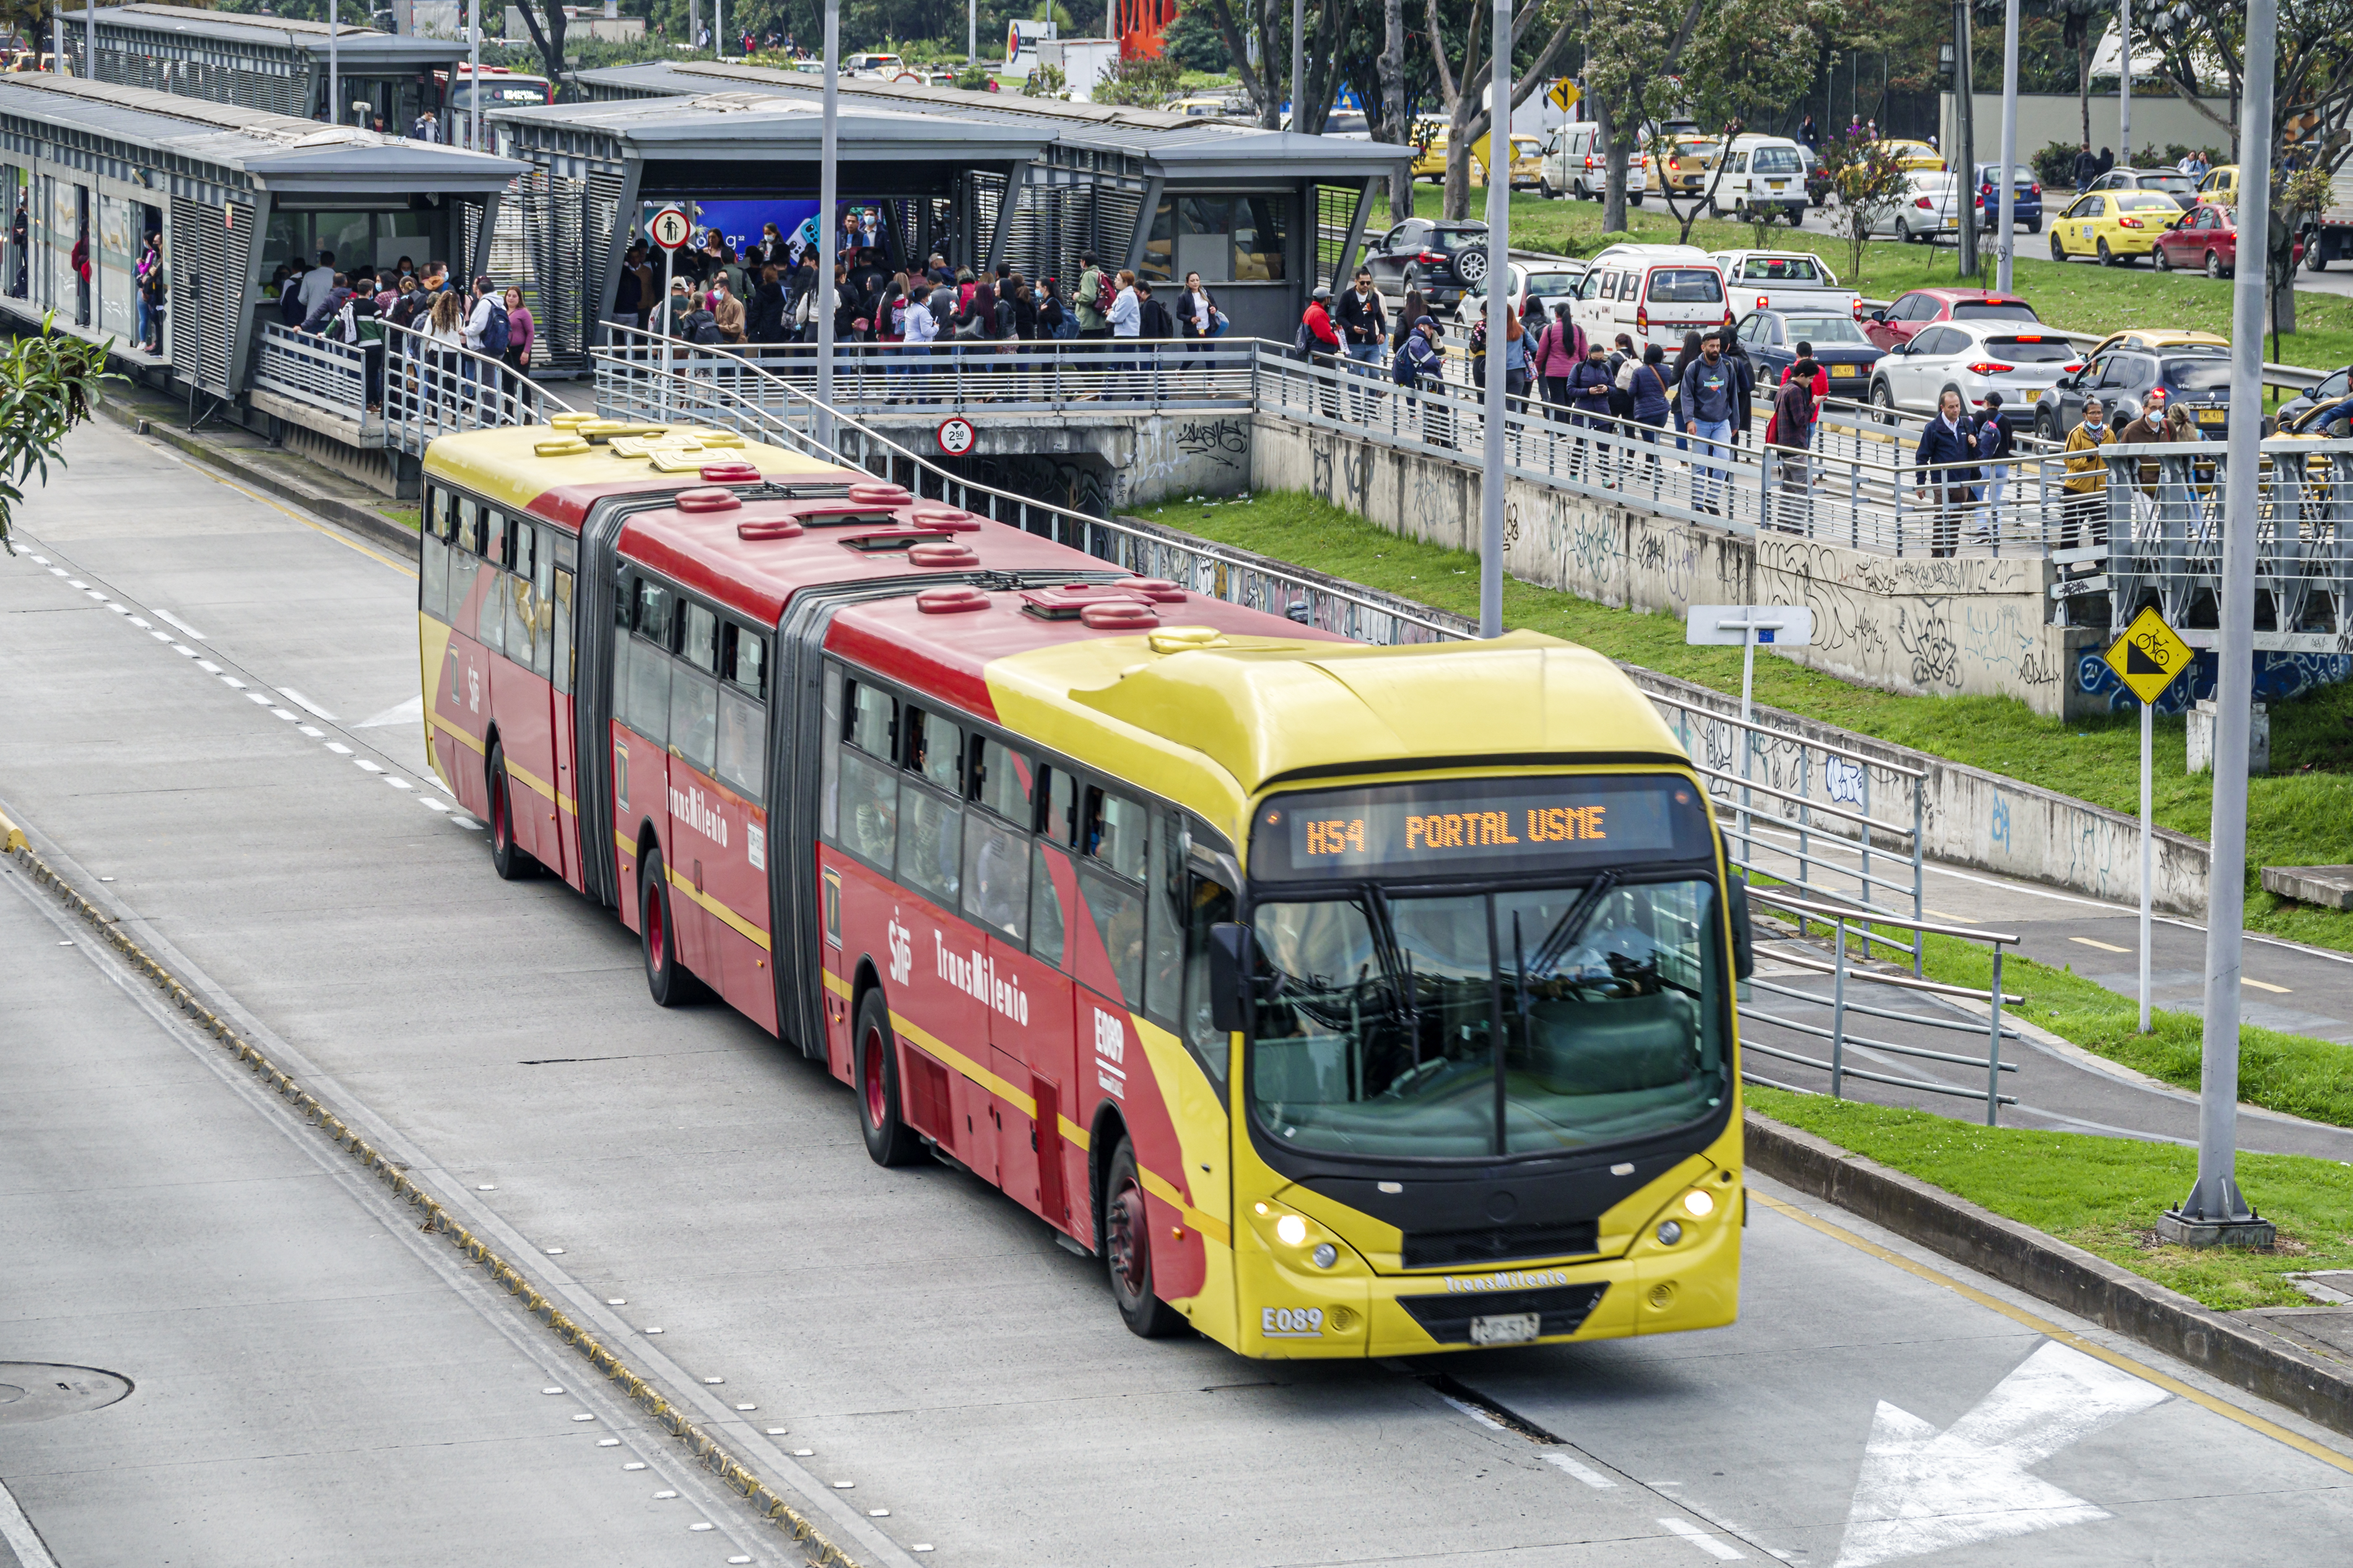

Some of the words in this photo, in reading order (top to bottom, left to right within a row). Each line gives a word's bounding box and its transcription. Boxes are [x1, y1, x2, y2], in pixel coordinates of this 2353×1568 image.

[1406, 812, 1519, 849] PORTAL
[1528, 806, 1606, 842] USME
[934, 929, 1028, 1027] TransMilenio
[1094, 1007, 1124, 1065] E089
[1443, 1269, 1567, 1293] TransMilenio
[1262, 1307, 1324, 1332] E089
